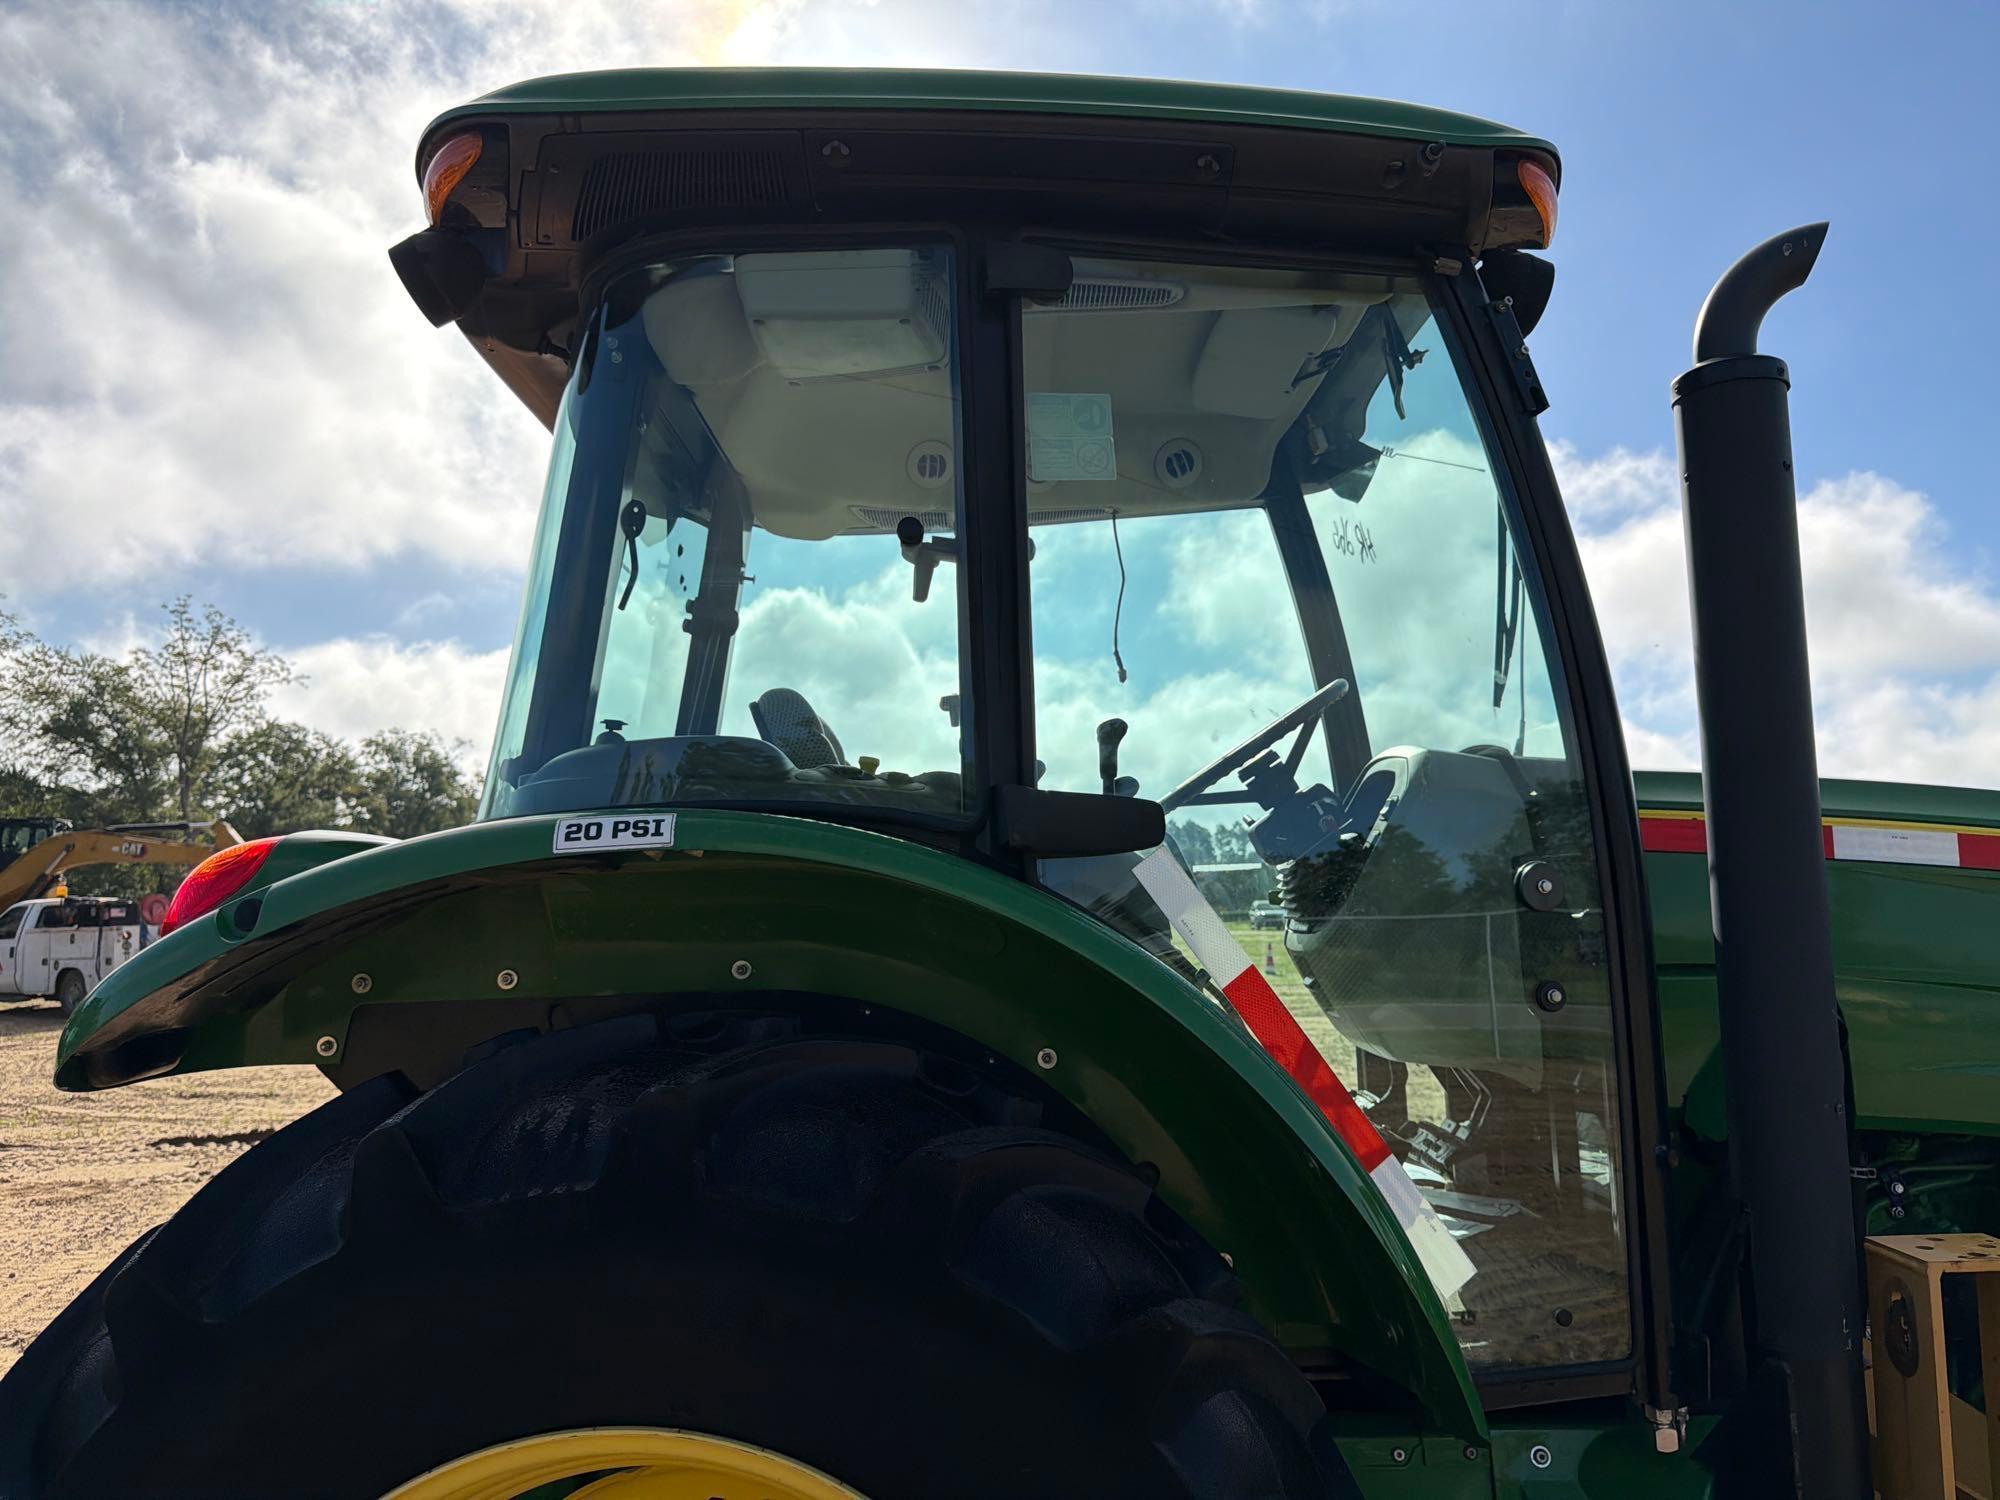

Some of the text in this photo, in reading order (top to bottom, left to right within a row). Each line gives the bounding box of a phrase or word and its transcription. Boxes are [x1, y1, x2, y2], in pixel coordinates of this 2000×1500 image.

[564, 819, 665, 842] 20 PSI
[121, 842, 143, 855] CAT
